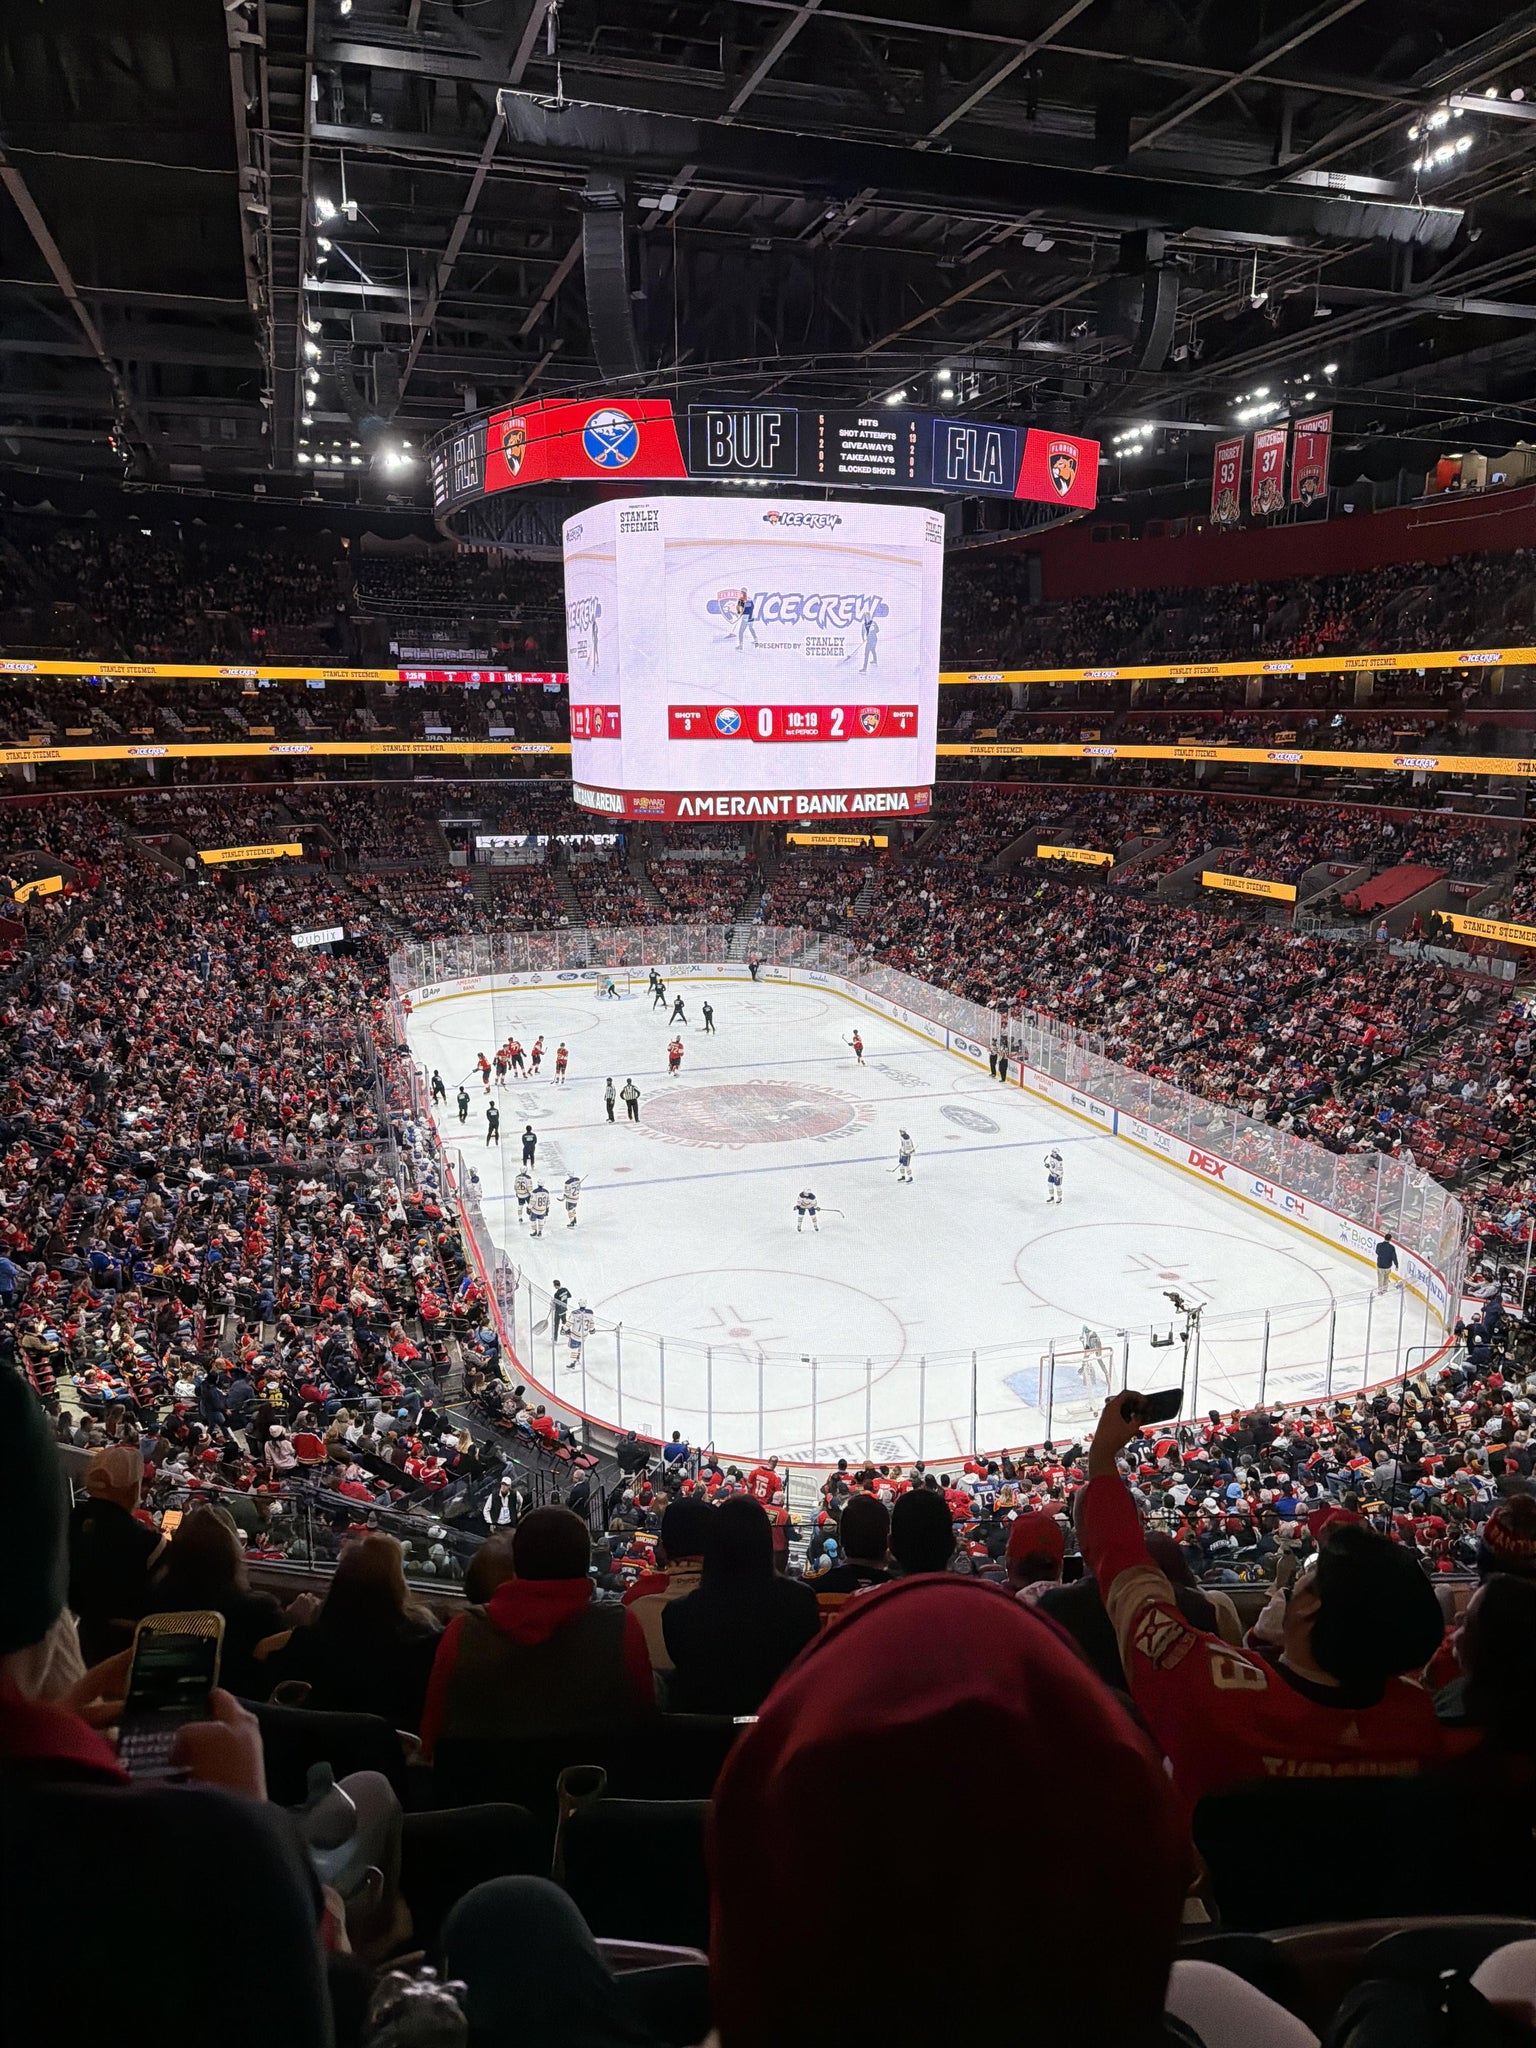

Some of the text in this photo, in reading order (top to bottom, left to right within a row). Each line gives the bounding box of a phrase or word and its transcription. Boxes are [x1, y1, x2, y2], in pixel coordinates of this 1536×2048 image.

[819, 414, 824, 425] 5
[858, 418, 878, 427] HITS
[707, 411, 780, 467] BUF
[839, 429, 896, 440] SHOT ATTEMPTS
[819, 439, 824, 448] 2
[842, 442, 893, 452] GIVEAWAYS
[1307, 438, 1314, 459] 1
[910, 445, 915, 454] 2
[1218, 446, 1240, 461] TORREY
[840, 453, 895, 463] TAKEAWAYS
[947, 427, 1002, 484] FLA
[1262, 450, 1277, 472] 37
[453, 434, 478, 492] FLA
[819, 462, 824, 472] 2
[839, 465, 896, 475] BLOCKED SHOTS
[1221, 463, 1235, 484] 93
[619, 510, 659, 523] STANLEY
[780, 512, 838, 531] ICE CREW
[619, 522, 659, 533] STEEMER
[753, 592, 883, 629] ICE CREW
[755, 642, 791, 650] PRESENTED
[805, 636, 845, 647] STANLEY
[805, 647, 845, 657] STEEMER
[1345, 658, 1396, 667] STANLEY STEEMER
[1467, 653, 1501, 663] ICE CREW
[4, 663, 36, 671] ICE CREW
[100, 666, 156, 674] STANLEY STEEMER
[1169, 666, 1220, 675] STANLEY STEEMER
[684, 719, 691, 731] 3
[758, 707, 773, 737] 0
[788, 712, 818, 727] 10:19
[830, 708, 844, 736] 2
[900, 718, 905, 729] 4
[148, 747, 168, 756] CREW
[382, 744, 410, 752] STANLEY
[532, 745, 552, 753] CREW
[1174, 748, 1217, 758] STANLEY STEEMER
[6, 750, 61, 760] STANLEY STEEMER
[1404, 758, 1438, 768] ICE CREW
[596, 792, 626, 814] ARENA
[677, 796, 793, 816] AMERANT
[796, 794, 848, 814] BANK
[851, 792, 910, 812] ARENA
[222, 848, 275, 859] STANLEY STEEMER
[1223, 878, 1272, 893] STANLEY STEEMER
[1463, 920, 1497, 935] STANLEY
[297, 931, 336, 946] Publix
[456, 978, 481, 986] AMERANT
[748, 1079, 861, 1100] AMERANT
[1188, 1150, 1228, 1180] DEX
[516, 1181, 525, 1191] 26
[1255, 1181, 1273, 1199] CH
[1285, 1196, 1305, 1214] CH
[1351, 1230, 1377, 1249] BioSt
[755, 1480, 767, 1498] 16
